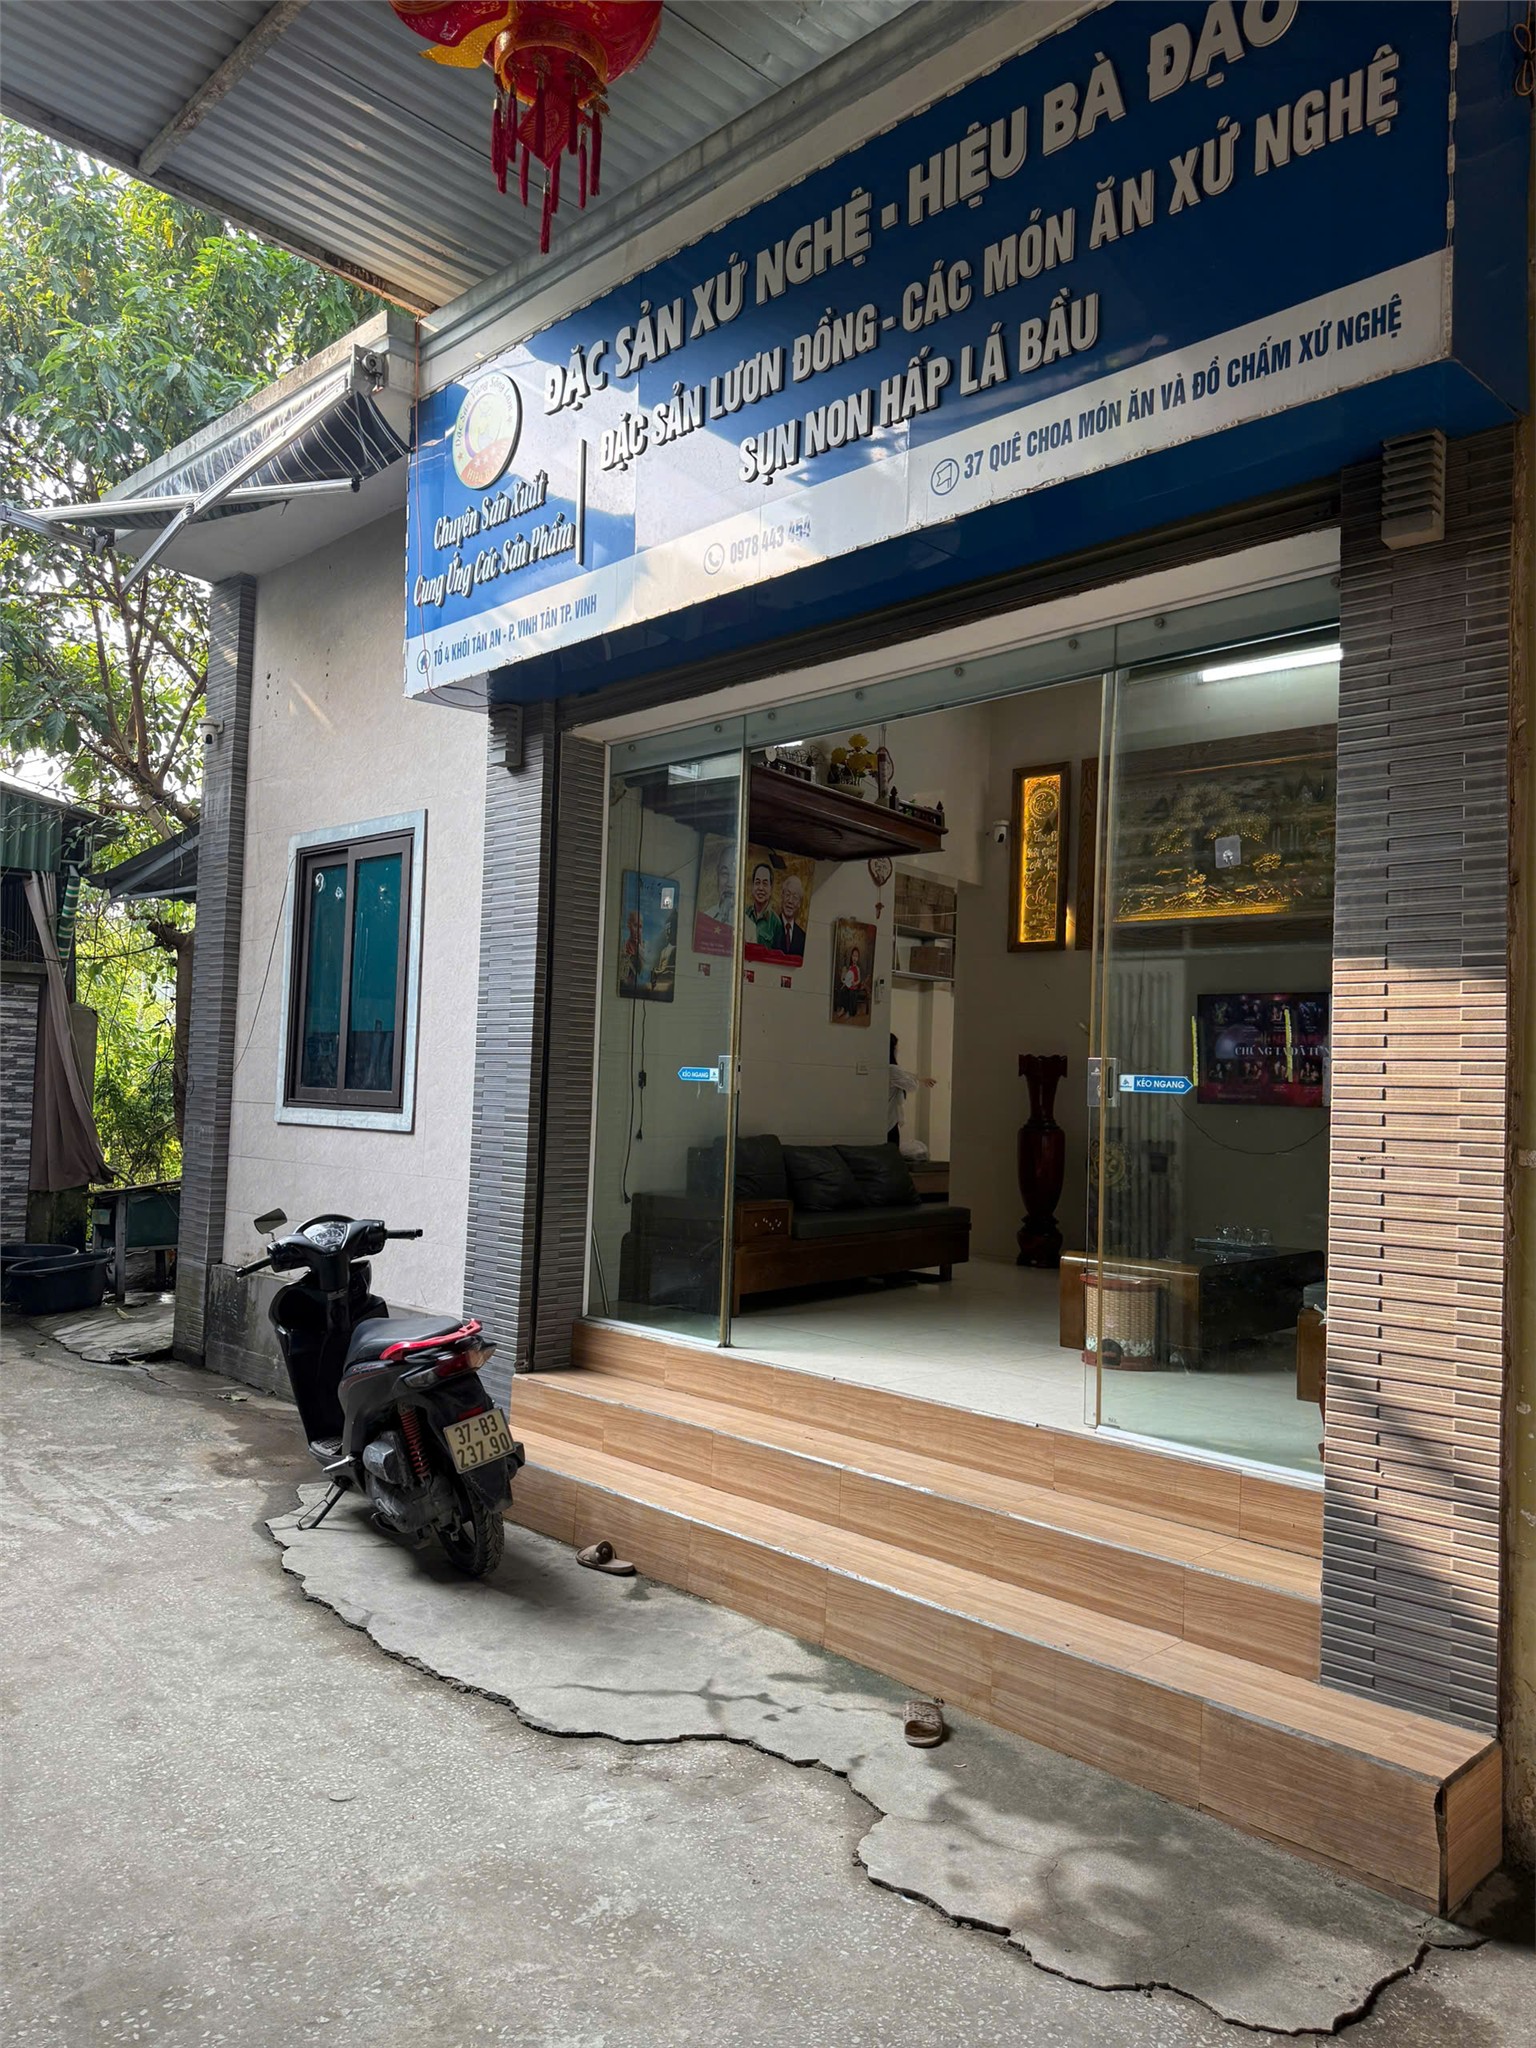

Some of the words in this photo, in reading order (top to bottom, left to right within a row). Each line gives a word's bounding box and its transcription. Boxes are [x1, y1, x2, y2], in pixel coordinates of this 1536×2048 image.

[543, 338, 607, 414] ĐẶC
[615, 297, 686, 379] SẢN
[689, 252, 748, 339] XỨ
[756, 187, 873, 305] NGHỆ
[908, 106, 1028, 226] HIỆU
[1042, 52, 1126, 156] BÀ
[600, 411, 648, 471] ĐẶC
[651, 381, 705, 446] SẢN
[710, 346, 787, 419] LƯƠN
[792, 303, 878, 383] ĐỒNG
[902, 259, 972, 333] CÁC
[984, 207, 1075, 298] MÓN
[1089, 169, 1154, 250] ĂN
[1169, 116, 1241, 215] XỨ
[1254, 43, 1399, 175] NGHỆ
[739, 419, 800, 486] SỤN
[805, 388, 872, 458] NON
[880, 346, 950, 427] HẤP
[960, 321, 1008, 396] LÁ
[1019, 287, 1099, 374] BẦU
[964, 450, 984, 479] 37
[989, 431, 1021, 473] QUÊ
[1027, 418, 1073, 457] CHOA
[1079, 400, 1122, 440] MÓN
[1127, 387, 1155, 423] ĂN
[1161, 373, 1186, 411] VÀ
[1192, 355, 1220, 401] ĐỒ
[1227, 336, 1291, 388] CHẤM
[1298, 320, 1332, 364] XỨ
[1337, 293, 1402, 350] NGHỆ
[434, 506, 481, 551] Chuyên
[481, 491, 511, 531] Sản
[509, 469, 549, 518] Xuất
[730, 534, 759, 564] 0978
[761, 525, 784, 552] 443
[413, 573, 446, 608] Cung
[446, 552, 475, 598] Ứng
[473, 547, 500, 585] Các
[500, 532, 530, 574] Sản
[529, 512, 576, 563] Phẩm
[434, 641, 444, 667] TỔ
[444, 646, 450, 663] 4
[451, 633, 470, 661] KHỐI
[472, 631, 488, 656] TÂN
[489, 628, 501, 649] AN
[508, 623, 515, 642] P.
[517, 616, 538, 639] VINH
[540, 607, 557, 631] TÂN
[560, 603, 572, 625] TP.
[575, 594, 597, 619] VINH
[1136, 1077, 1152, 1087] KÉO
[1154, 1080, 1185, 1089] NGANG
[455, 1415, 498, 1445] 37-B3
[457, 1432, 510, 1468] 237.90
